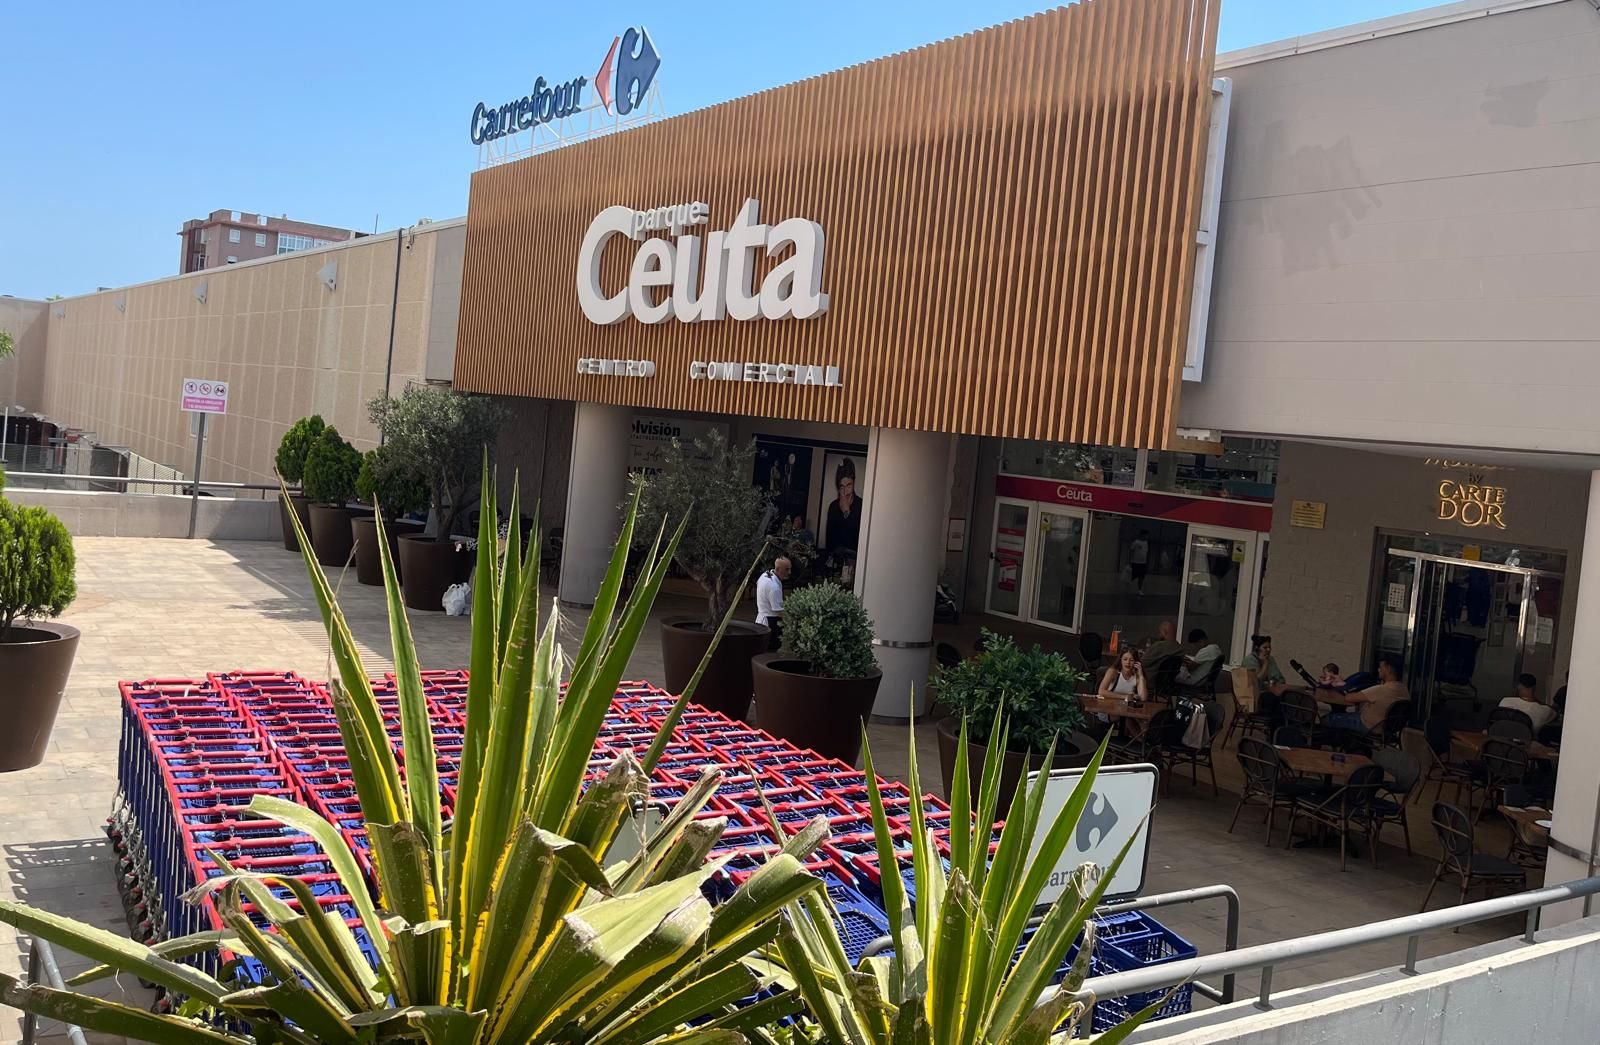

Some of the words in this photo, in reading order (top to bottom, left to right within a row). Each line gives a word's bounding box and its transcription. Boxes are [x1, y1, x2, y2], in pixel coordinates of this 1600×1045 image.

[470, 75, 588, 146] Carrefour
[633, 200, 709, 241] parque
[577, 197, 829, 325] Ceuta
[576, 358, 655, 378] CENTRO
[689, 360, 842, 387] COMERCIAL
[1056, 485, 1093, 502] Ceuta
[1439, 480, 1507, 505] CARTE
